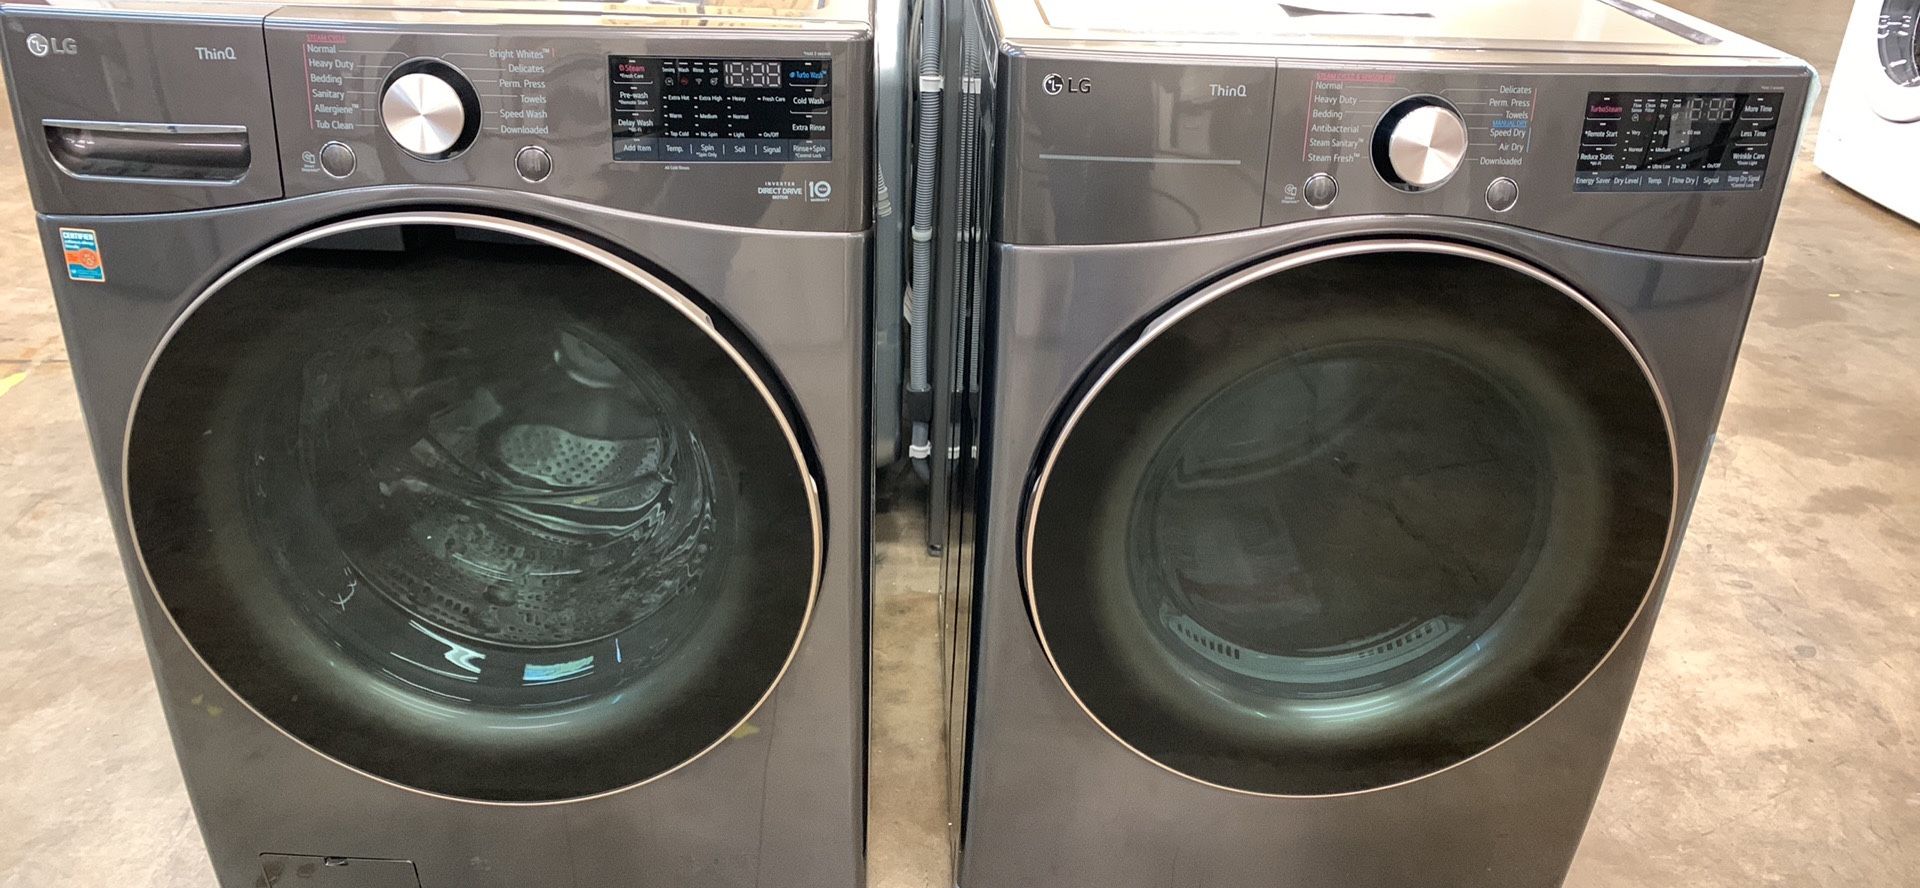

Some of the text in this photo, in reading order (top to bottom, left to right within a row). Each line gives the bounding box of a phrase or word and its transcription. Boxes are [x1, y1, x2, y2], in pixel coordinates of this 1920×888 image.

[51, 38, 77, 54] LG
[307, 44, 336, 53] Normal
[195, 46, 237, 60] ThinQ
[489, 49, 513, 60] Bright
[309, 59, 354, 70] Heavy Duty
[508, 64, 544, 73] Delicates
[625, 64, 645, 72] Steam
[311, 74, 342, 85] Bedding
[500, 79, 546, 88] Perm. Press
[1068, 77, 1091, 93] LG
[1315, 82, 1343, 90] Normal
[1500, 85, 1532, 94] Delicates
[312, 89, 345, 100] Sanitary
[620, 91, 648, 99] Pre-wash
[1209, 84, 1247, 97] ThinQ
[520, 95, 546, 104] Towels
[1314, 95, 1358, 105] Heavy Duty
[1489, 98, 1530, 107] Perm. Press
[1591, 105, 1622, 113] TurboSteam
[500, 109, 548, 119] Speed Wash
[1312, 110, 1343, 120] Bedding
[1506, 110, 1528, 119] Towels
[315, 120, 354, 130] Tub Clean
[618, 119, 635, 127] Delay
[500, 125, 548, 134] Downloaded
[1311, 124, 1359, 133] Antibacterial
[1490, 129, 1526, 139] Speed Dry
[1310, 138, 1330, 147] Steam
[666, 144, 683, 152] Temp.
[701, 144, 714, 152] Spin
[763, 146, 781, 154] Signal
[1499, 143, 1524, 153] Air Dry
[1308, 153, 1331, 162] Steam
[1480, 157, 1522, 165] Downloaded
[1576, 177, 1594, 185] Energy
[1614, 178, 1623, 186] Dry
[1686, 177, 1695, 185] Dry
[1703, 176, 1720, 184] Signal
[782, 187, 802, 195] DRIVE
[809, 181, 831, 198] 10
